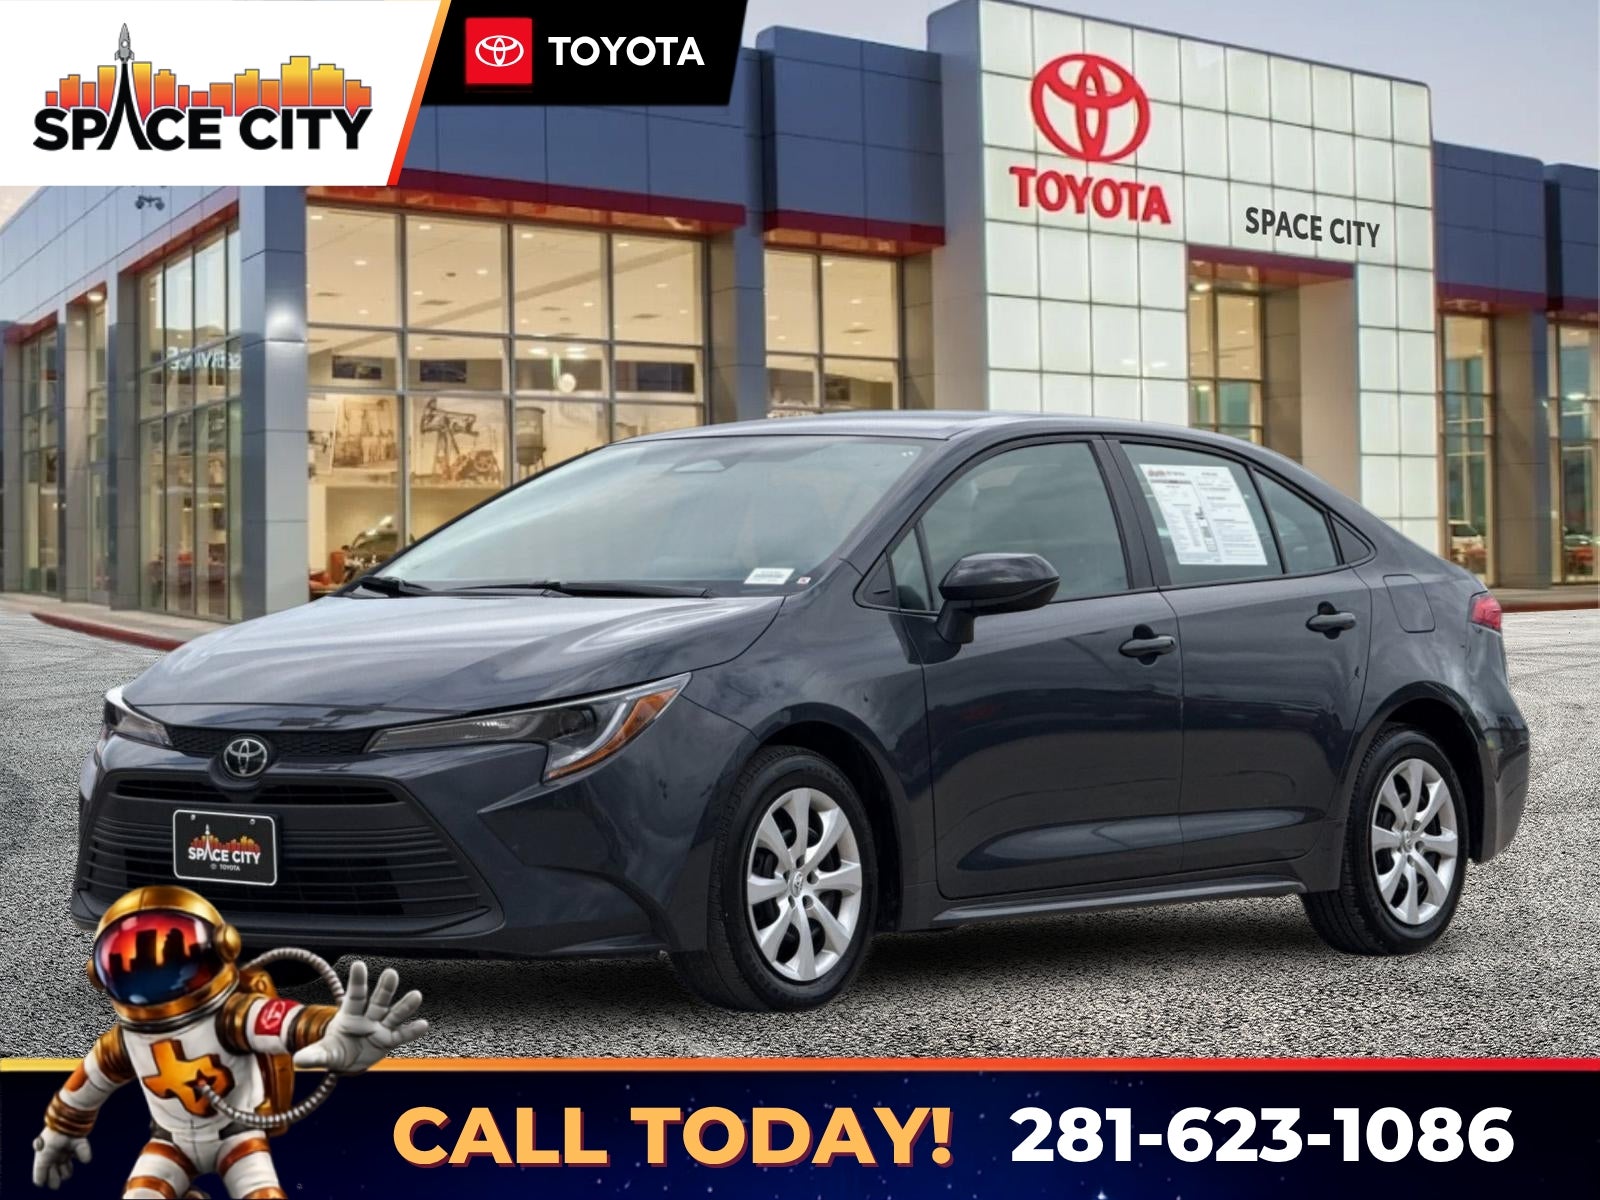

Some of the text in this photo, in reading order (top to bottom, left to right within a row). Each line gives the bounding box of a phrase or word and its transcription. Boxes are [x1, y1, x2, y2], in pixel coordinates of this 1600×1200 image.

[1009, 167, 1171, 224] TOYOTA
[1245, 206, 1381, 248] SPACE CITY
[188, 843, 261, 865] SPACE CITY
[219, 864, 241, 872] TOYOTA
